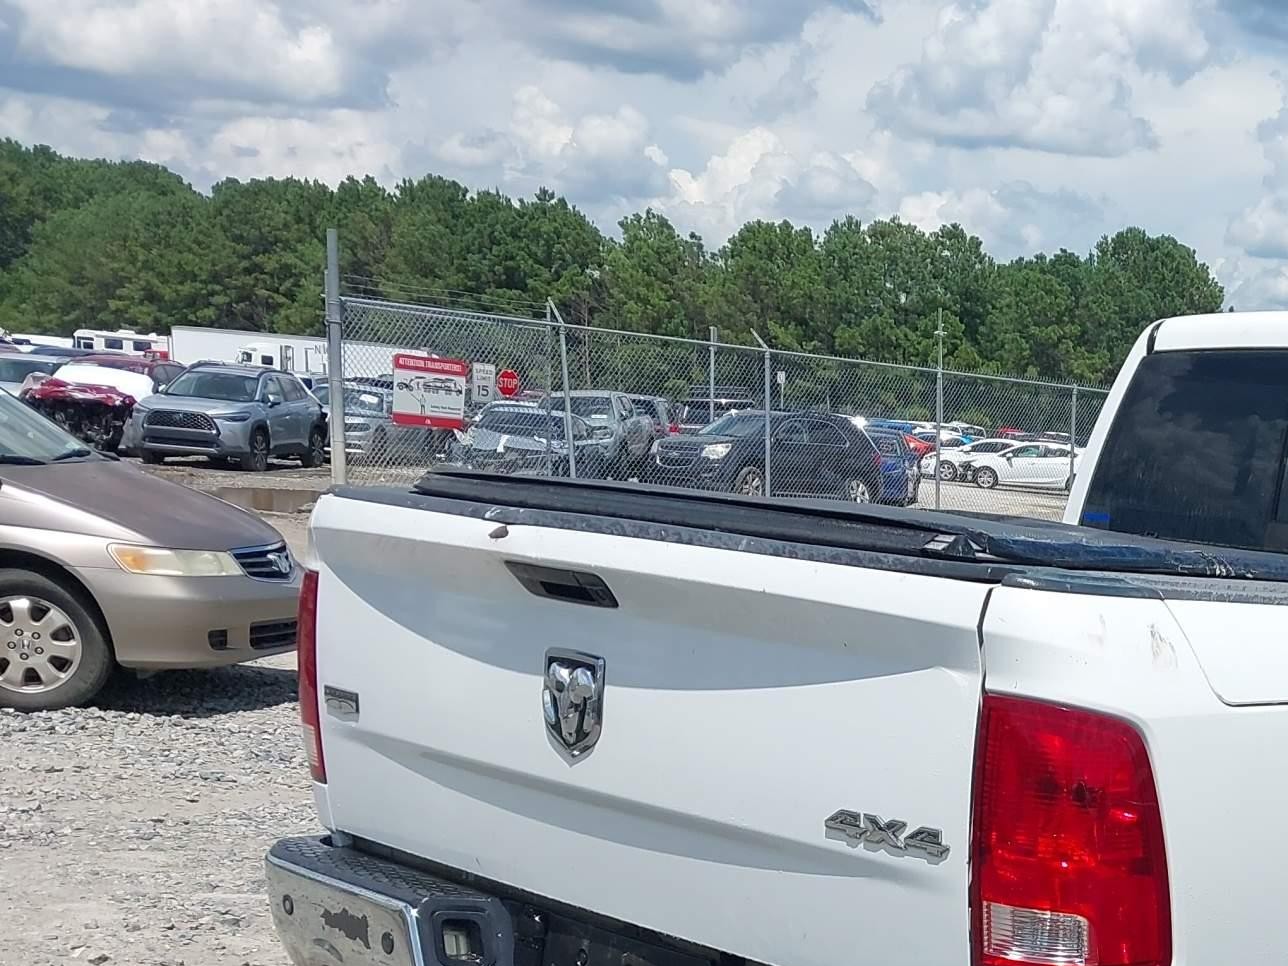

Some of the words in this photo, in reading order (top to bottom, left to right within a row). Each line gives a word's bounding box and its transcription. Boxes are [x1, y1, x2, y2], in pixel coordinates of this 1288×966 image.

[475, 368, 493, 376] SPEED
[498, 377, 518, 389] STOP
[477, 385, 490, 397] 15
